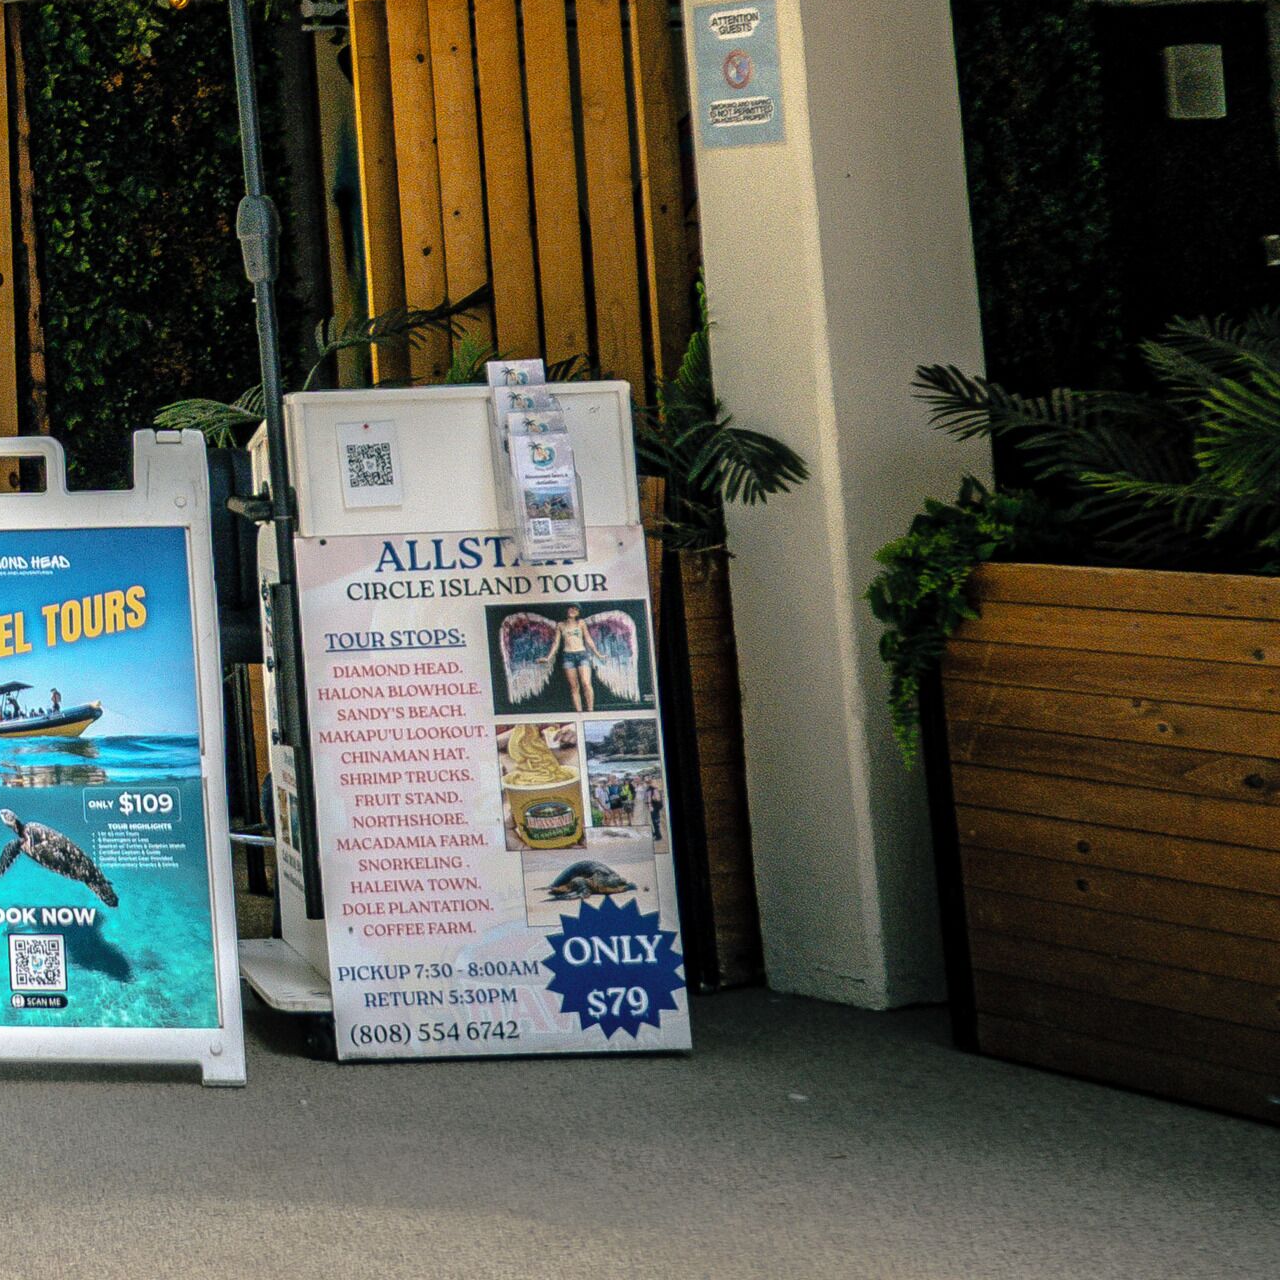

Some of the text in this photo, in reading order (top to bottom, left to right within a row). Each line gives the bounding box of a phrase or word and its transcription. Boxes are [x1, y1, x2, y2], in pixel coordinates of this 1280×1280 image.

[711, 13, 759, 27] ATTENTION
[718, 23, 752, 35] GUESTS
[718, 109, 732, 117] NOT
[31, 554, 71, 570] HEAD
[347, 573, 609, 602] CIRCLE ISLAND TOUR
[41, 585, 148, 647] TOURS
[325, 628, 466, 651] TOUR STOPS:
[333, 661, 464, 679] DIAMOND HEAD.
[317, 682, 483, 701] HALONA BLOWHOLE.
[337, 704, 467, 722] SANDY'S BEACH.
[318, 725, 489, 744] MAKAPU'U LOOKOUT.
[340, 747, 470, 765] CHINAMAN HAT.
[339, 768, 475, 786] SHRIMP TRUCKS.
[88, 791, 174, 816] ONLY $109
[354, 791, 464, 807] FRUIT STAND.
[352, 812, 469, 829] NORTHSHORE.
[336, 833, 489, 852] MACADAMIA FARM.
[350, 877, 482, 894] HALEIWA TOWN.
[342, 898, 495, 916] DOLE PLANTATION.
[42, 907, 97, 926] NOW
[363, 921, 477, 938] COFFEE FARM.
[563, 934, 664, 963] ONLY
[338, 965, 411, 982] PICKUP
[415, 963, 453, 979] 7:30
[468, 960, 540, 977] 8:00AM
[27, 997, 61, 1007] SCAN ME
[364, 987, 518, 1008] RETURN 5:30PM
[587, 986, 649, 1019] $79
[350, 1020, 520, 1046] (808) 554 6742
